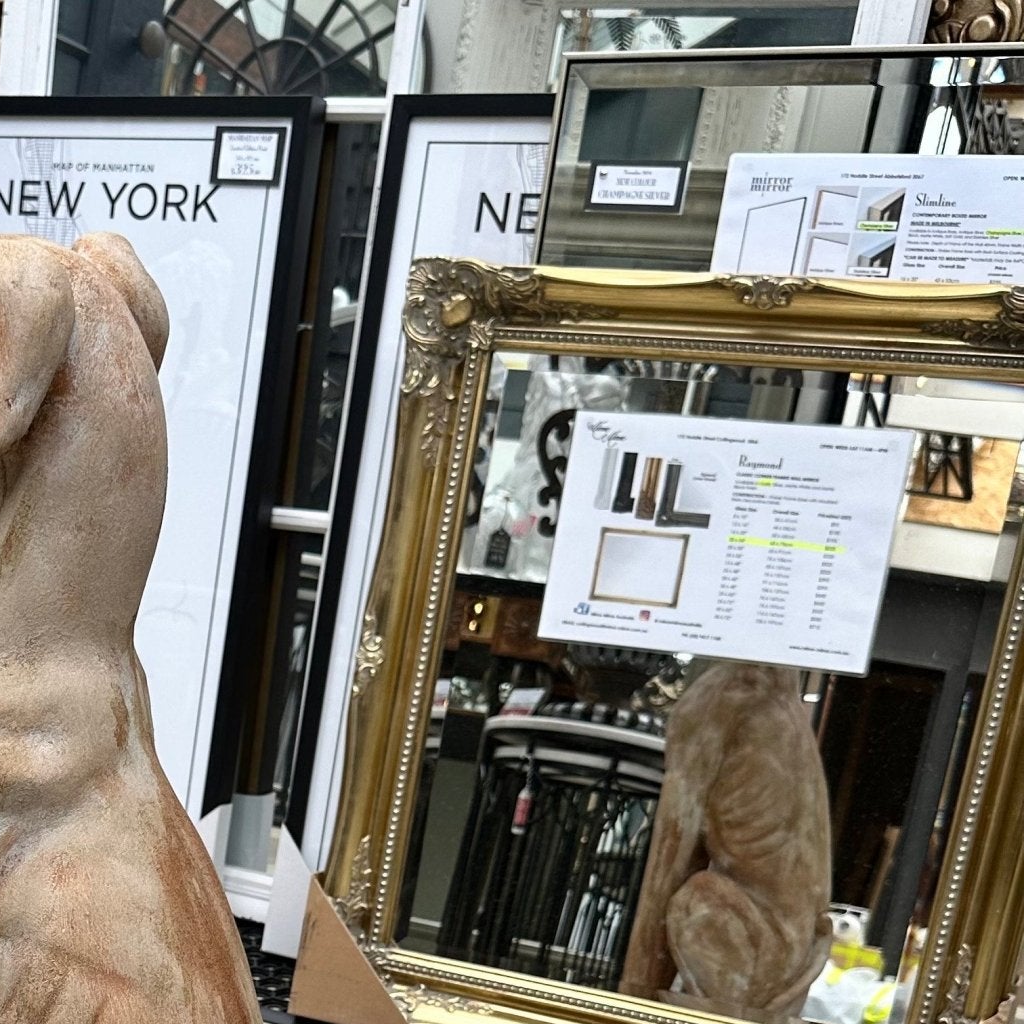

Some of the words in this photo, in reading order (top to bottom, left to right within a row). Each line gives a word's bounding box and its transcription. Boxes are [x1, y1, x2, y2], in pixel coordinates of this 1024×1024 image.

[53, 162, 73, 171] MAP
[75, 163, 90, 172] OF
[92, 163, 155, 173] MANHATTAN
[752, 174, 794, 184] mirror
[751, 184, 792, 194] mirror
[101, 181, 222, 223] YORK
[915, 192, 957, 207] Slimline
[739, 454, 784, 470] Raymond
